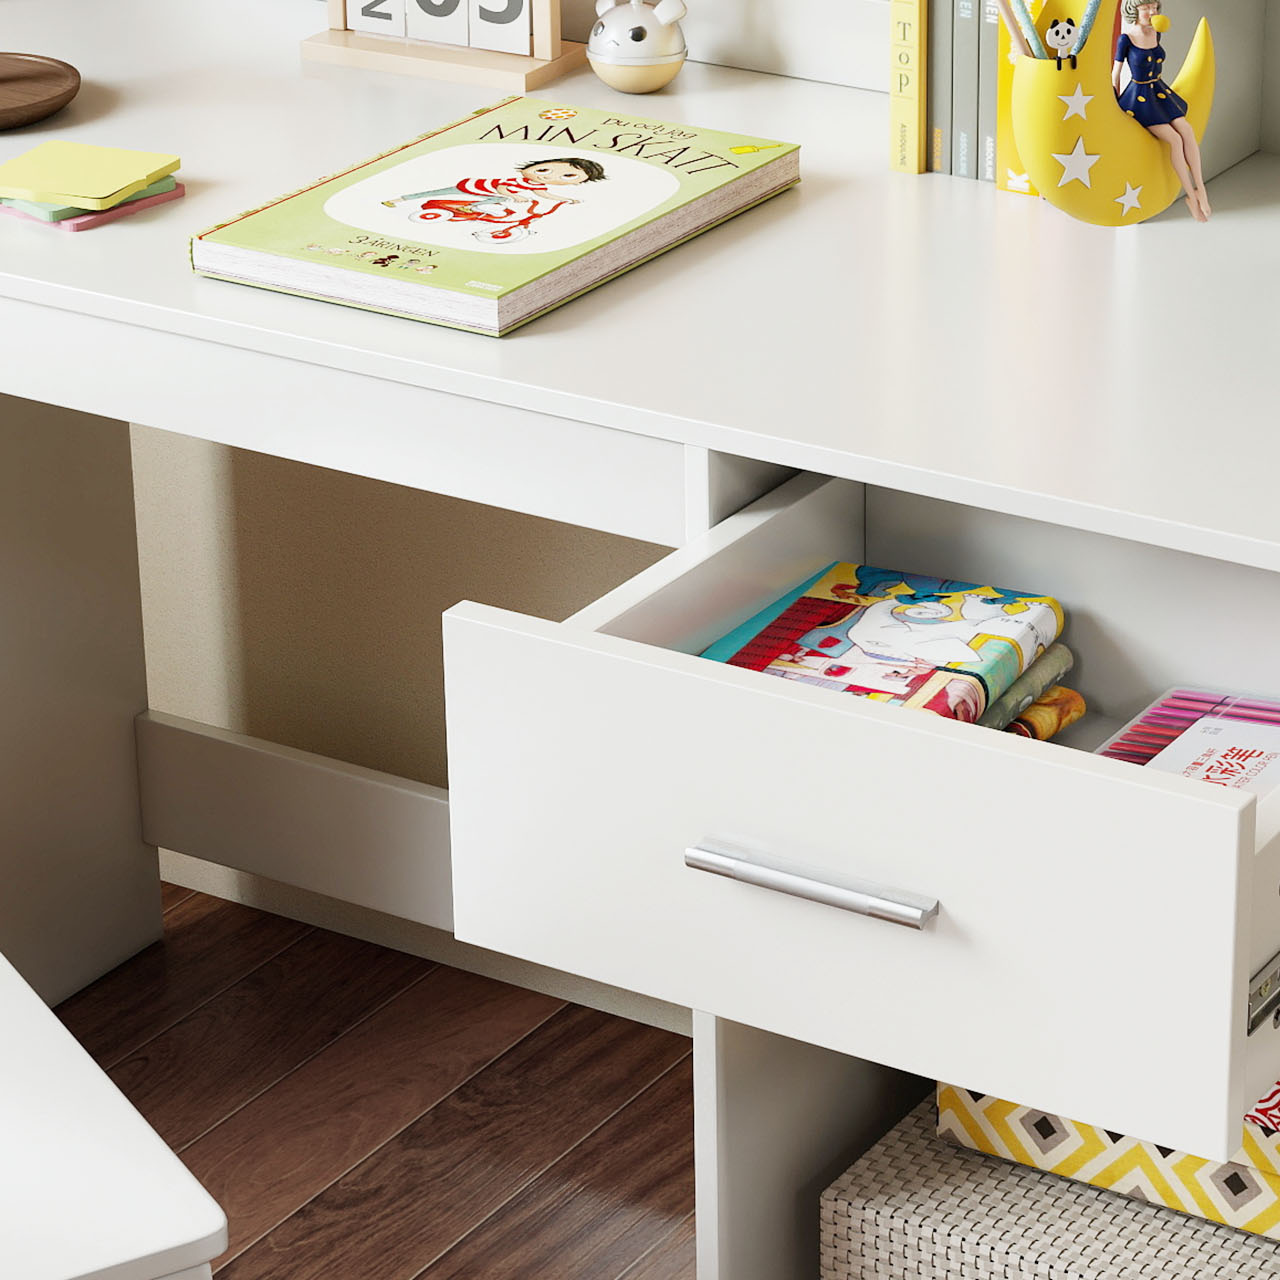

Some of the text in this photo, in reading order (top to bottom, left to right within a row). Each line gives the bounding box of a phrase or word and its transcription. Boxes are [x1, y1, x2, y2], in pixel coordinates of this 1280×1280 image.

[896, 20, 912, 93] Top
[478, 124, 740, 175] MIN SKATT
